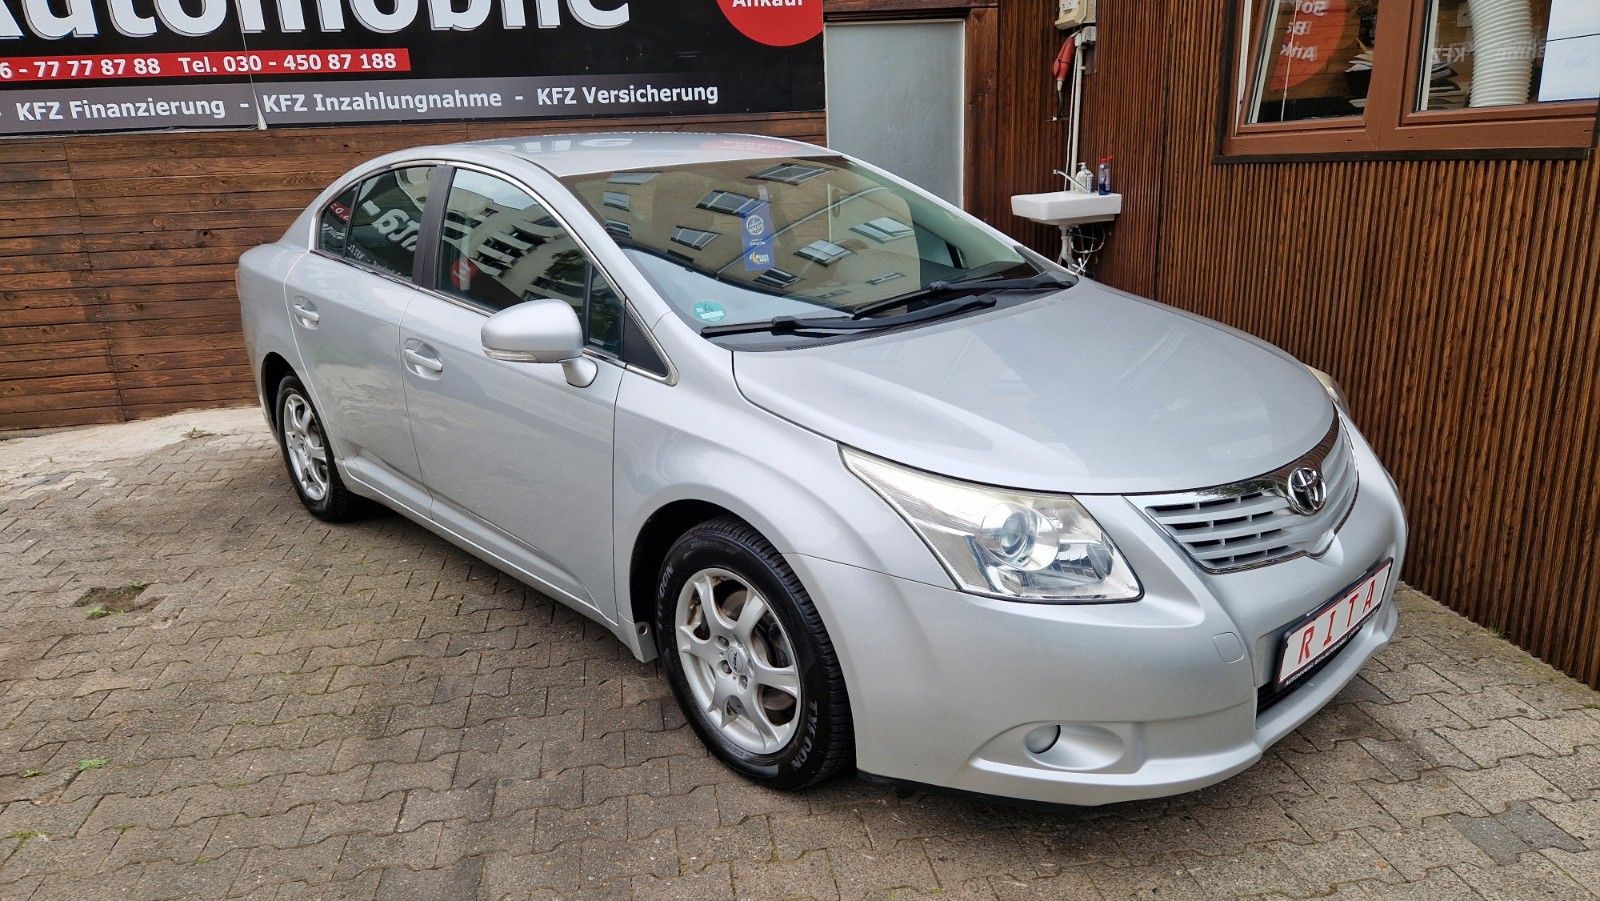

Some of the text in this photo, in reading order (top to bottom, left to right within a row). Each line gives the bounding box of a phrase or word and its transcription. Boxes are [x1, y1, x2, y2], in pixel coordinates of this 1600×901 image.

[33, 61, 59, 78] 77
[67, 60, 93, 77] 77
[101, 58, 126, 76] 87
[133, 57, 161, 75] 88
[178, 56, 218, 74] Tel.
[223, 55, 262, 72] 030
[284, 54, 322, 71] 450
[328, 53, 352, 70] 87
[361, 53, 397, 70] 188
[16, 101, 64, 121] KFZ
[69, 98, 226, 119] Finanzierung
[263, 94, 308, 113] KFZ
[313, 90, 502, 112] Inzahlungnahme
[537, 87, 577, 105] KFZ
[583, 84, 719, 104] Versicherung
[1297, 579, 1377, 665] RITA
